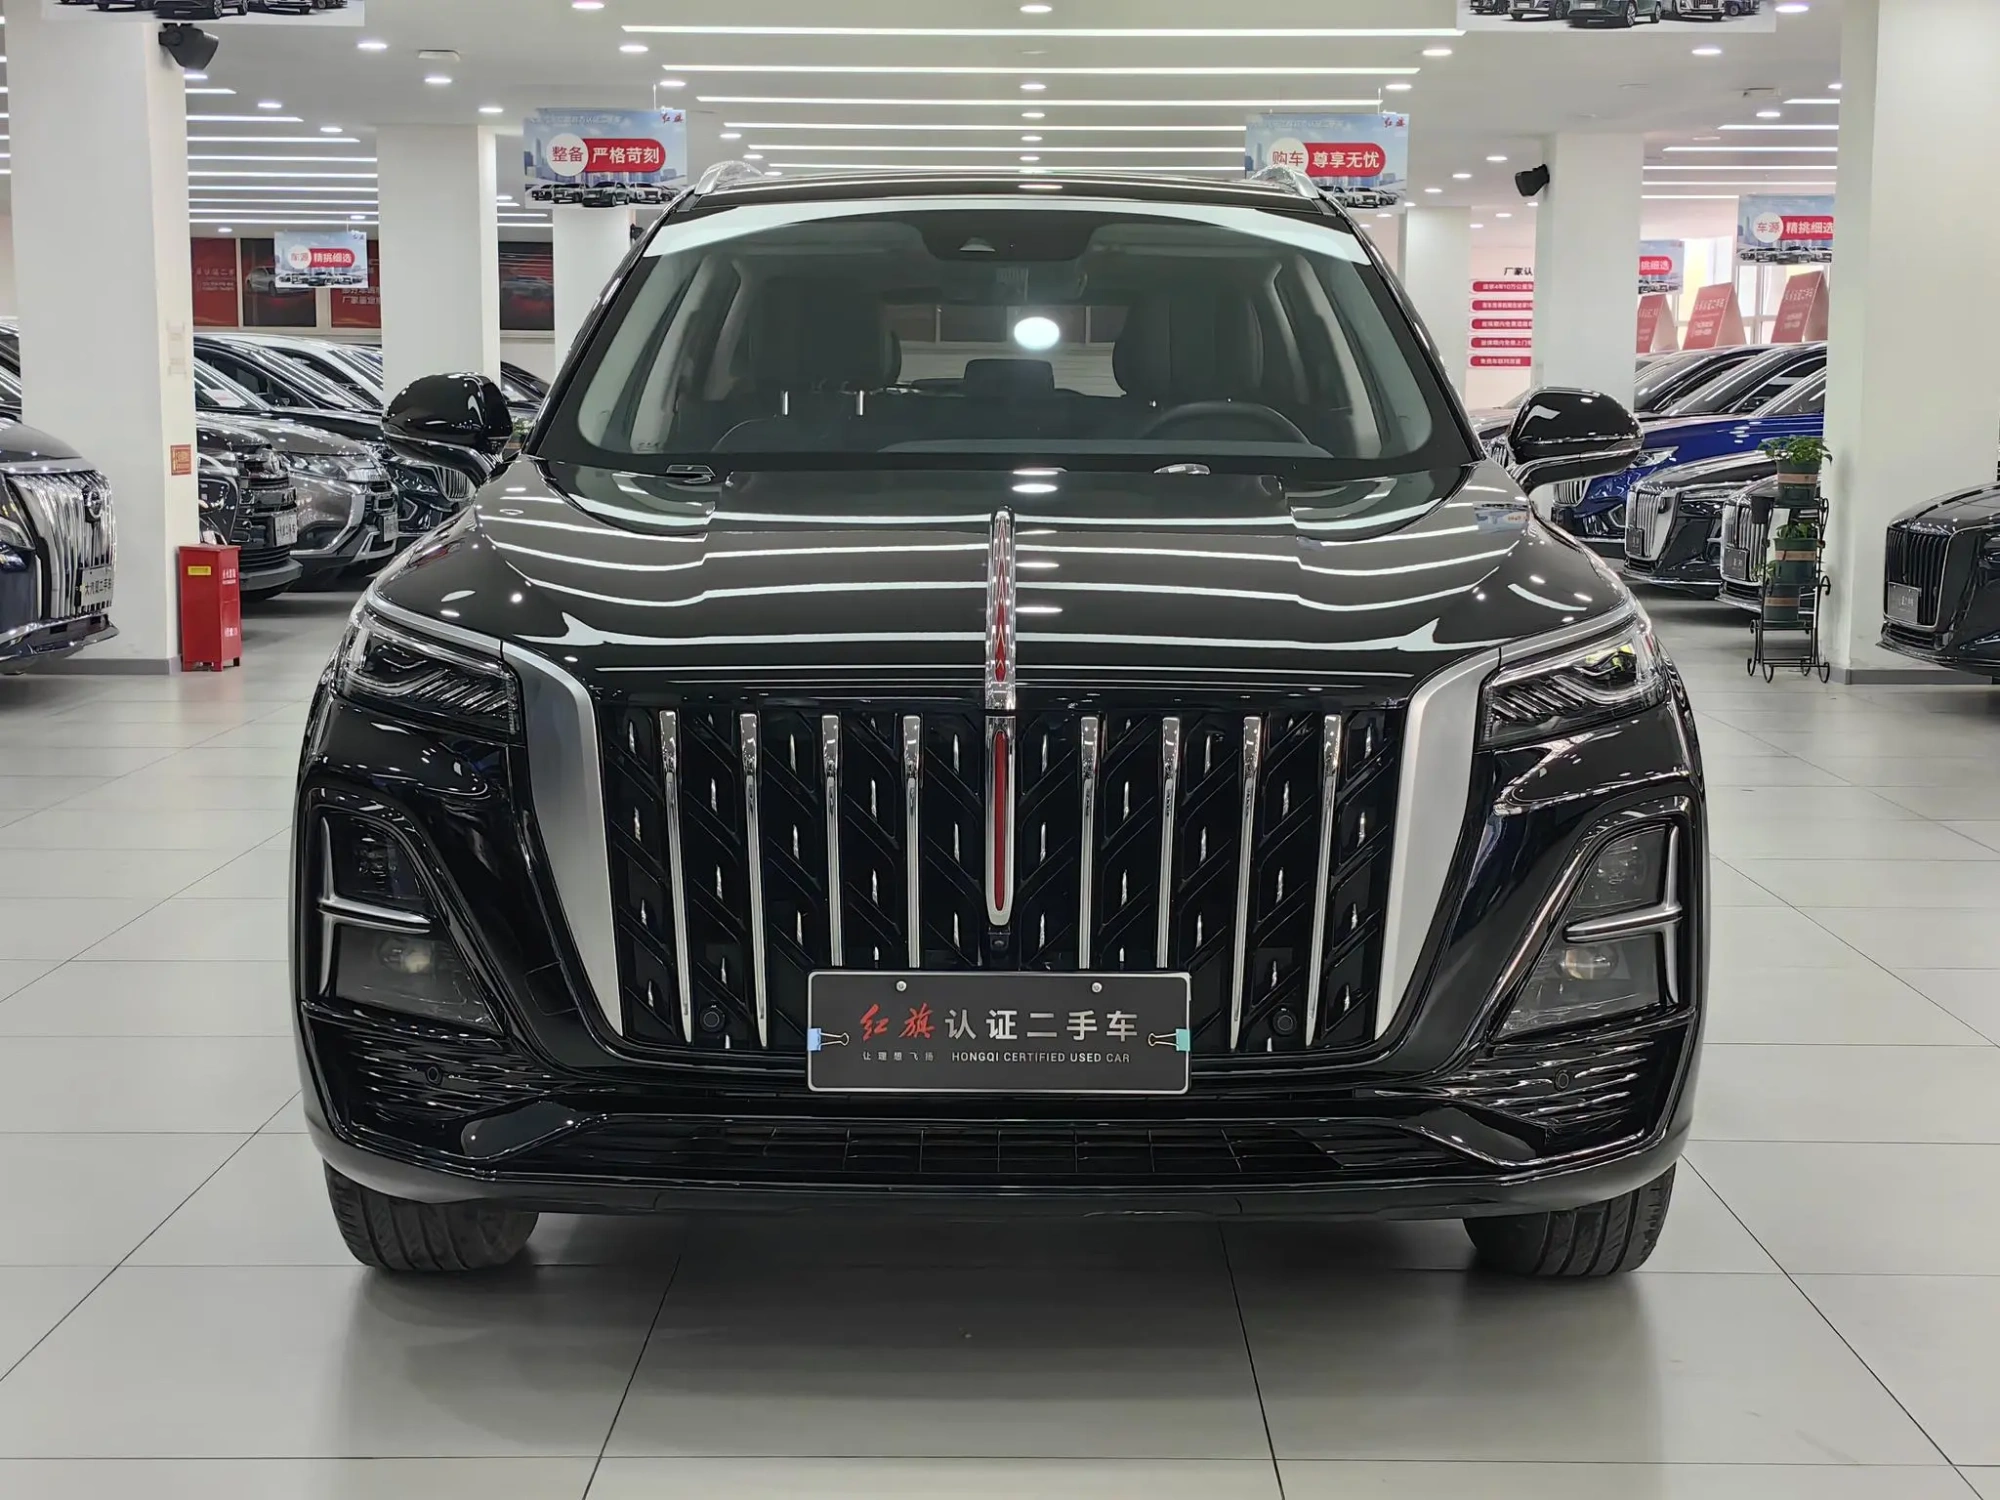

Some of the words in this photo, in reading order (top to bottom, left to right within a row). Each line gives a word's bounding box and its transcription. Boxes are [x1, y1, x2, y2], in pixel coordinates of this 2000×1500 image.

[552, 146, 584, 162] 整备
[592, 147, 660, 164] 严格苛刻
[1272, 151, 1304, 167] 购车
[1312, 151, 1380, 168] 尊享无忧
[1785, 221, 1834, 234] 精挑细选
[862, 1051, 934, 1061] 让理想飞扬
[952, 1051, 999, 1063] HONGQI
[1003, 1051, 1066, 1063] CERTIFIED
[1070, 1052, 1102, 1063] USED
[1106, 1053, 1131, 1063] CAR
